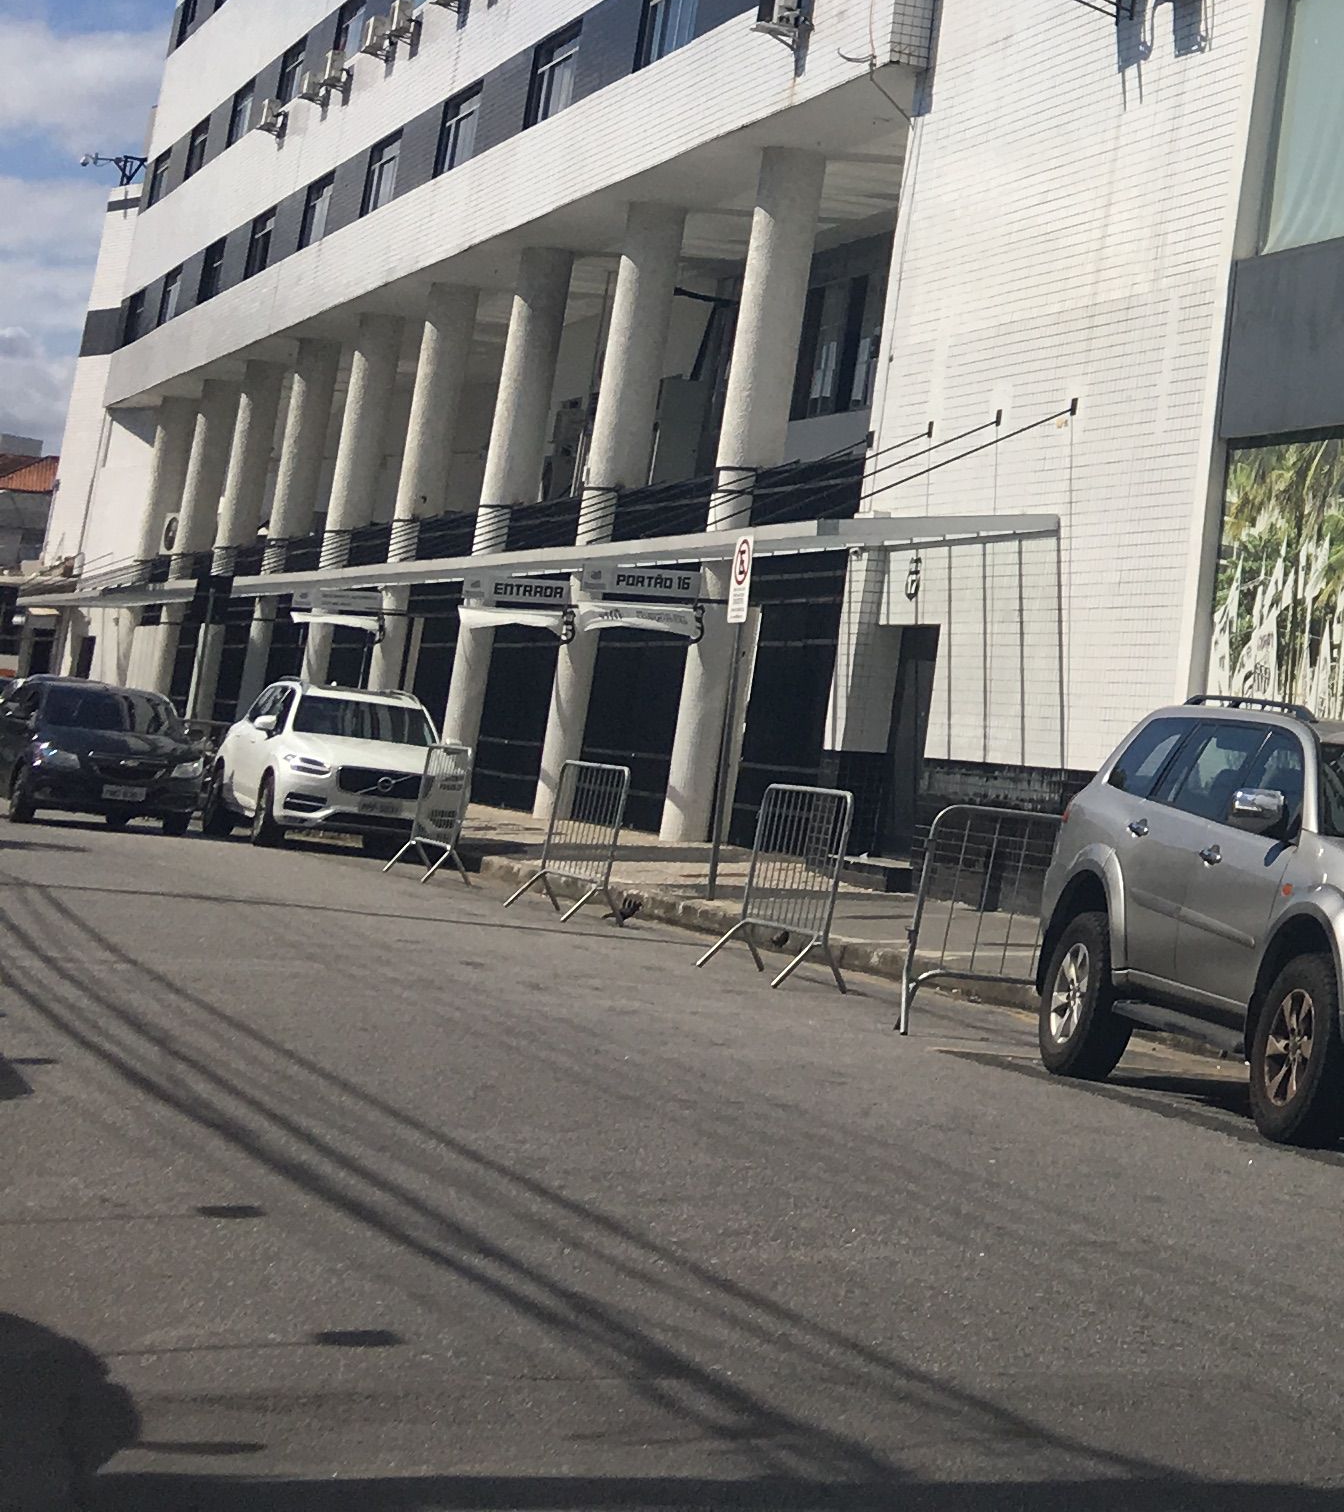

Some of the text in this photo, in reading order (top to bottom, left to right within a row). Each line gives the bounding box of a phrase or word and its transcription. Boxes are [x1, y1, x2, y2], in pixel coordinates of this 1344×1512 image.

[616, 573, 692, 590] PORTÃO 16
[493, 582, 565, 599] ENTRADA
